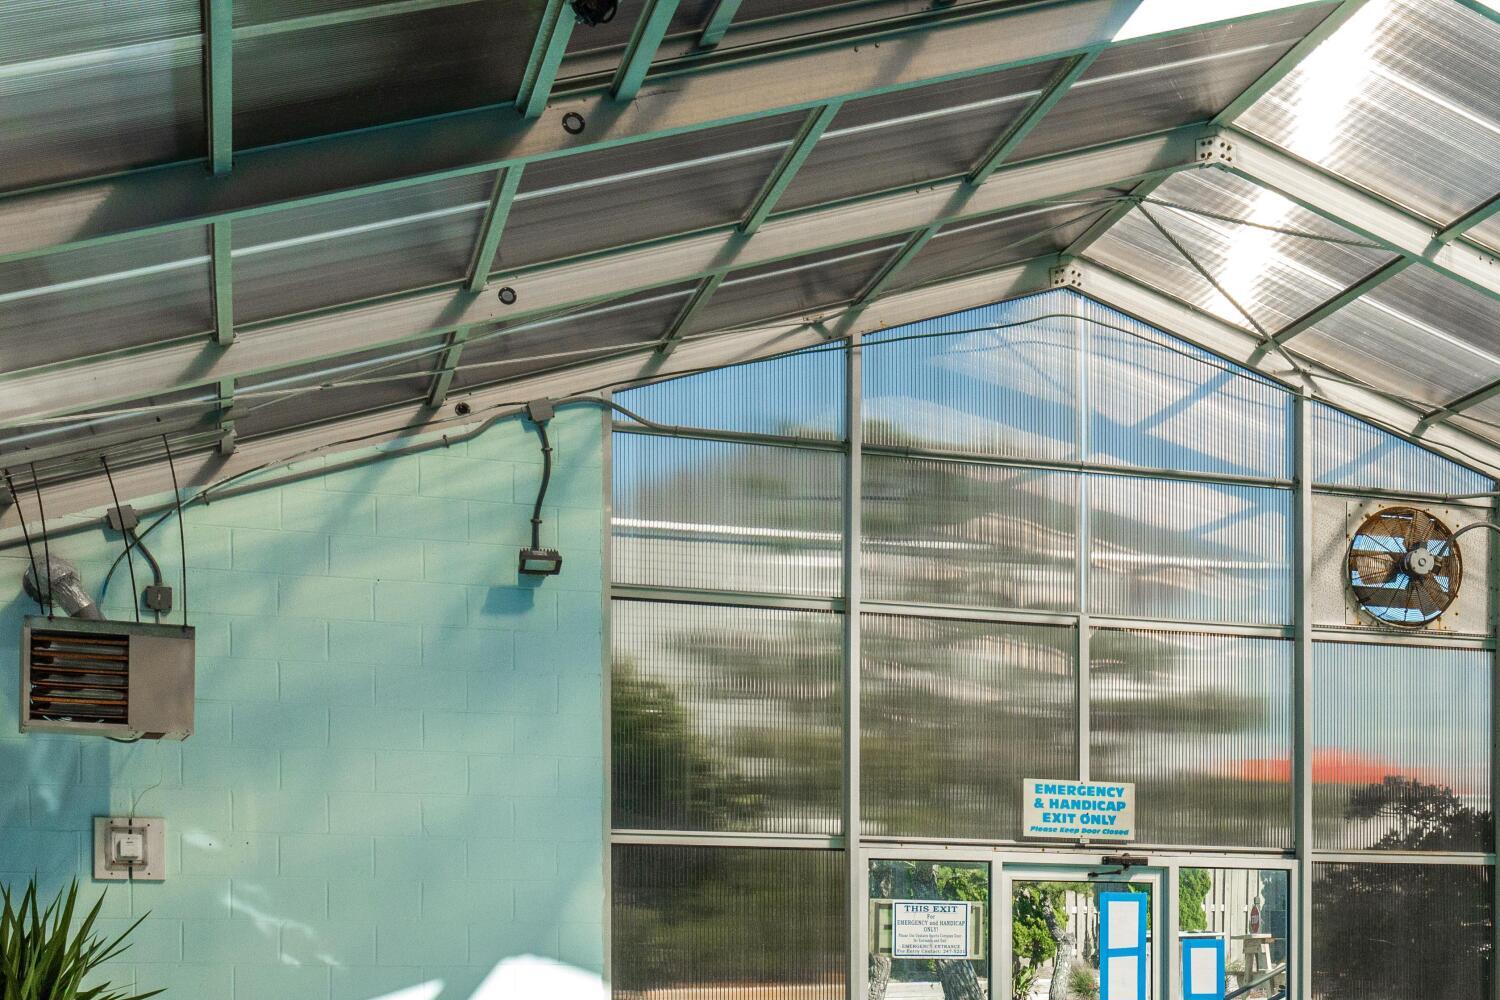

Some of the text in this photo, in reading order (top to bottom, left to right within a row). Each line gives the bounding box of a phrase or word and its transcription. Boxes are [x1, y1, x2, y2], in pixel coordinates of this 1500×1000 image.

[1034, 783, 1125, 798] EMERGENCY
[1033, 798, 1127, 812] & HANDICAP
[1042, 812, 1117, 826] EXIT ONLY
[1030, 825, 1058, 833] Please
[1060, 827, 1080, 835] Keep
[1102, 828, 1130, 836] Closed
[904, 904, 958, 913] THIS EXIT
